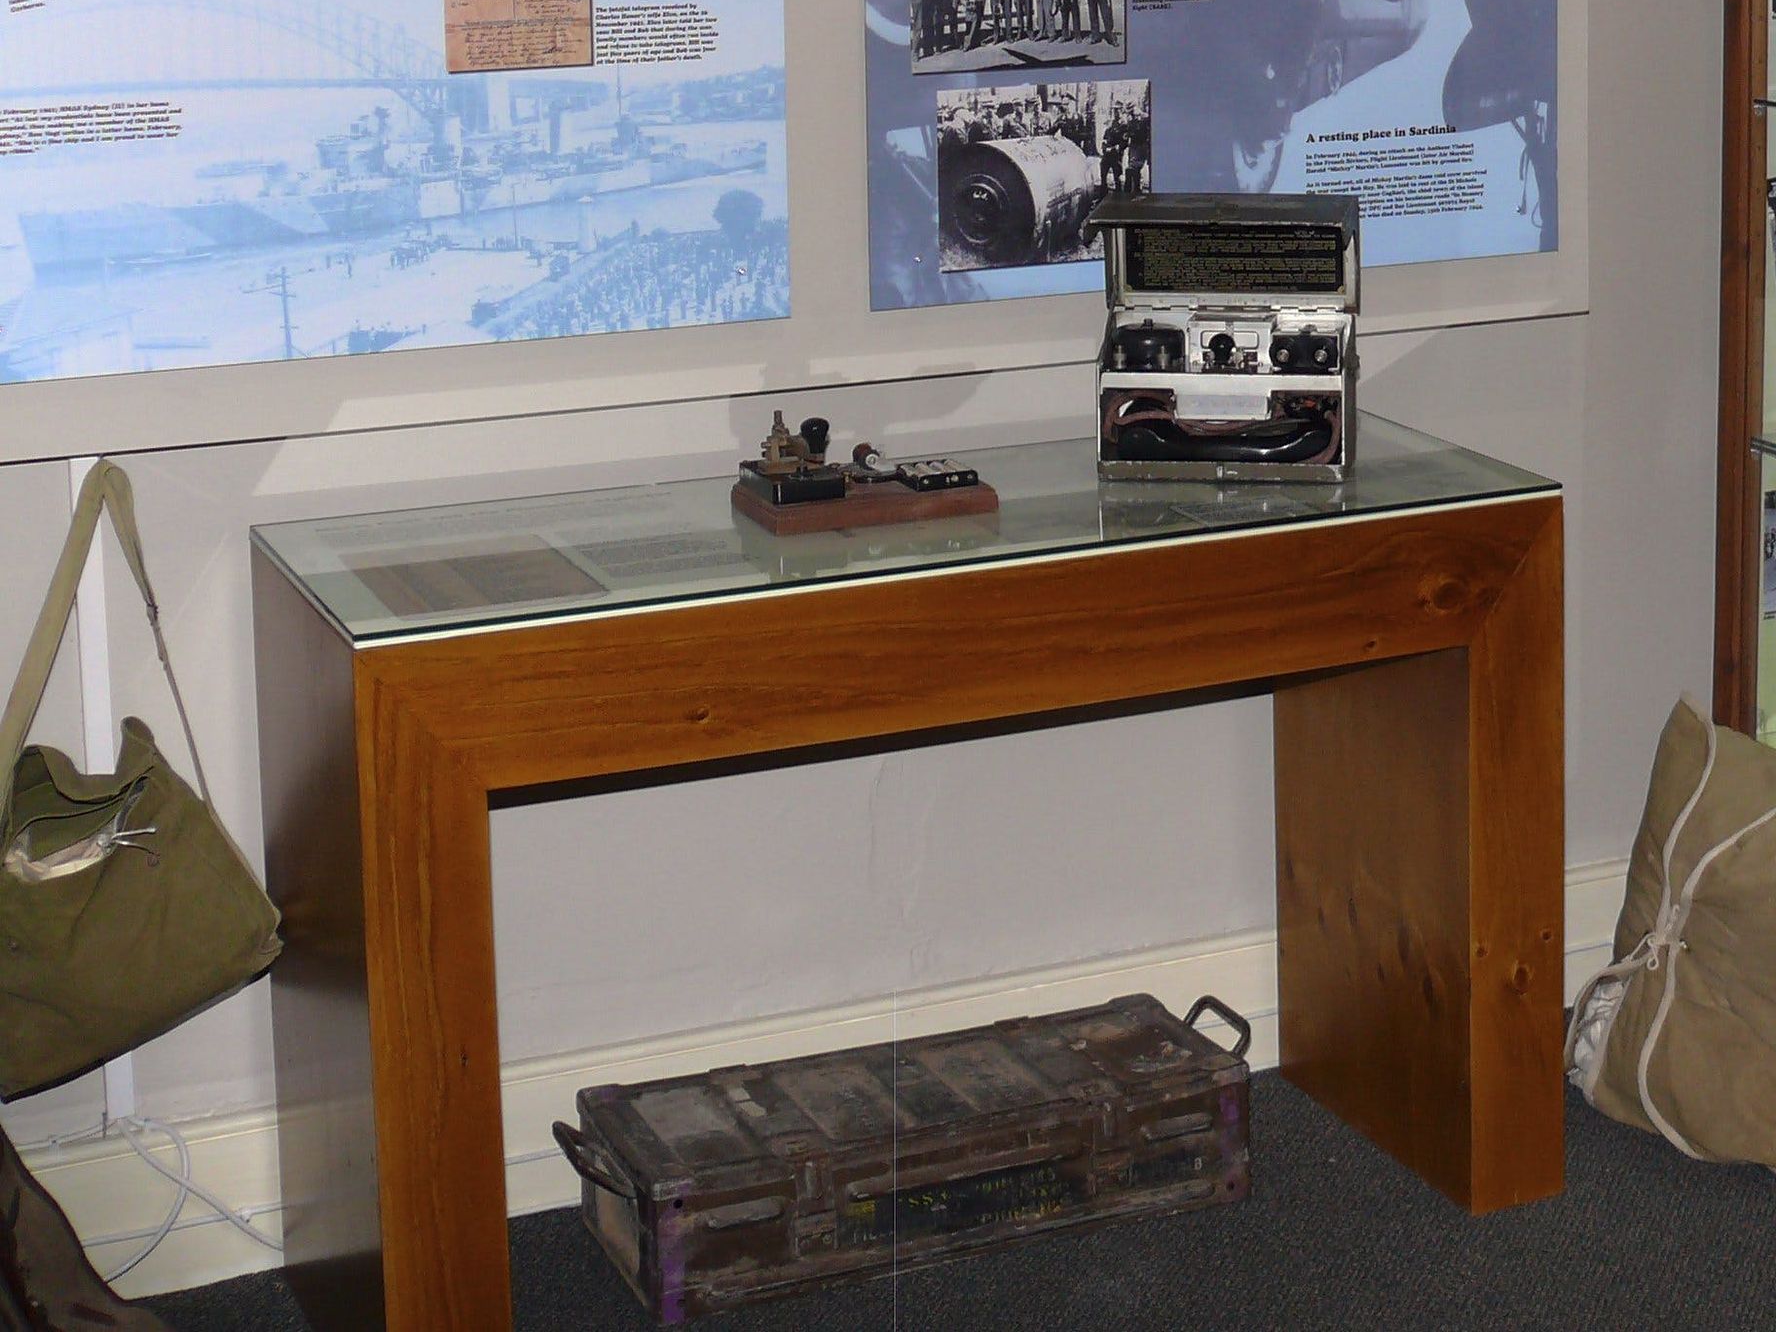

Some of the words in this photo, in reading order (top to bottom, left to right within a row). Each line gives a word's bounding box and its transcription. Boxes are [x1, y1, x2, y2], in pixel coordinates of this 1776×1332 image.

[1306, 133, 1315, 143] A
[1319, 132, 1359, 142] resting
[1362, 130, 1391, 141] place
[1394, 128, 1406, 137] in
[1409, 125, 1456, 136] Sardinia
